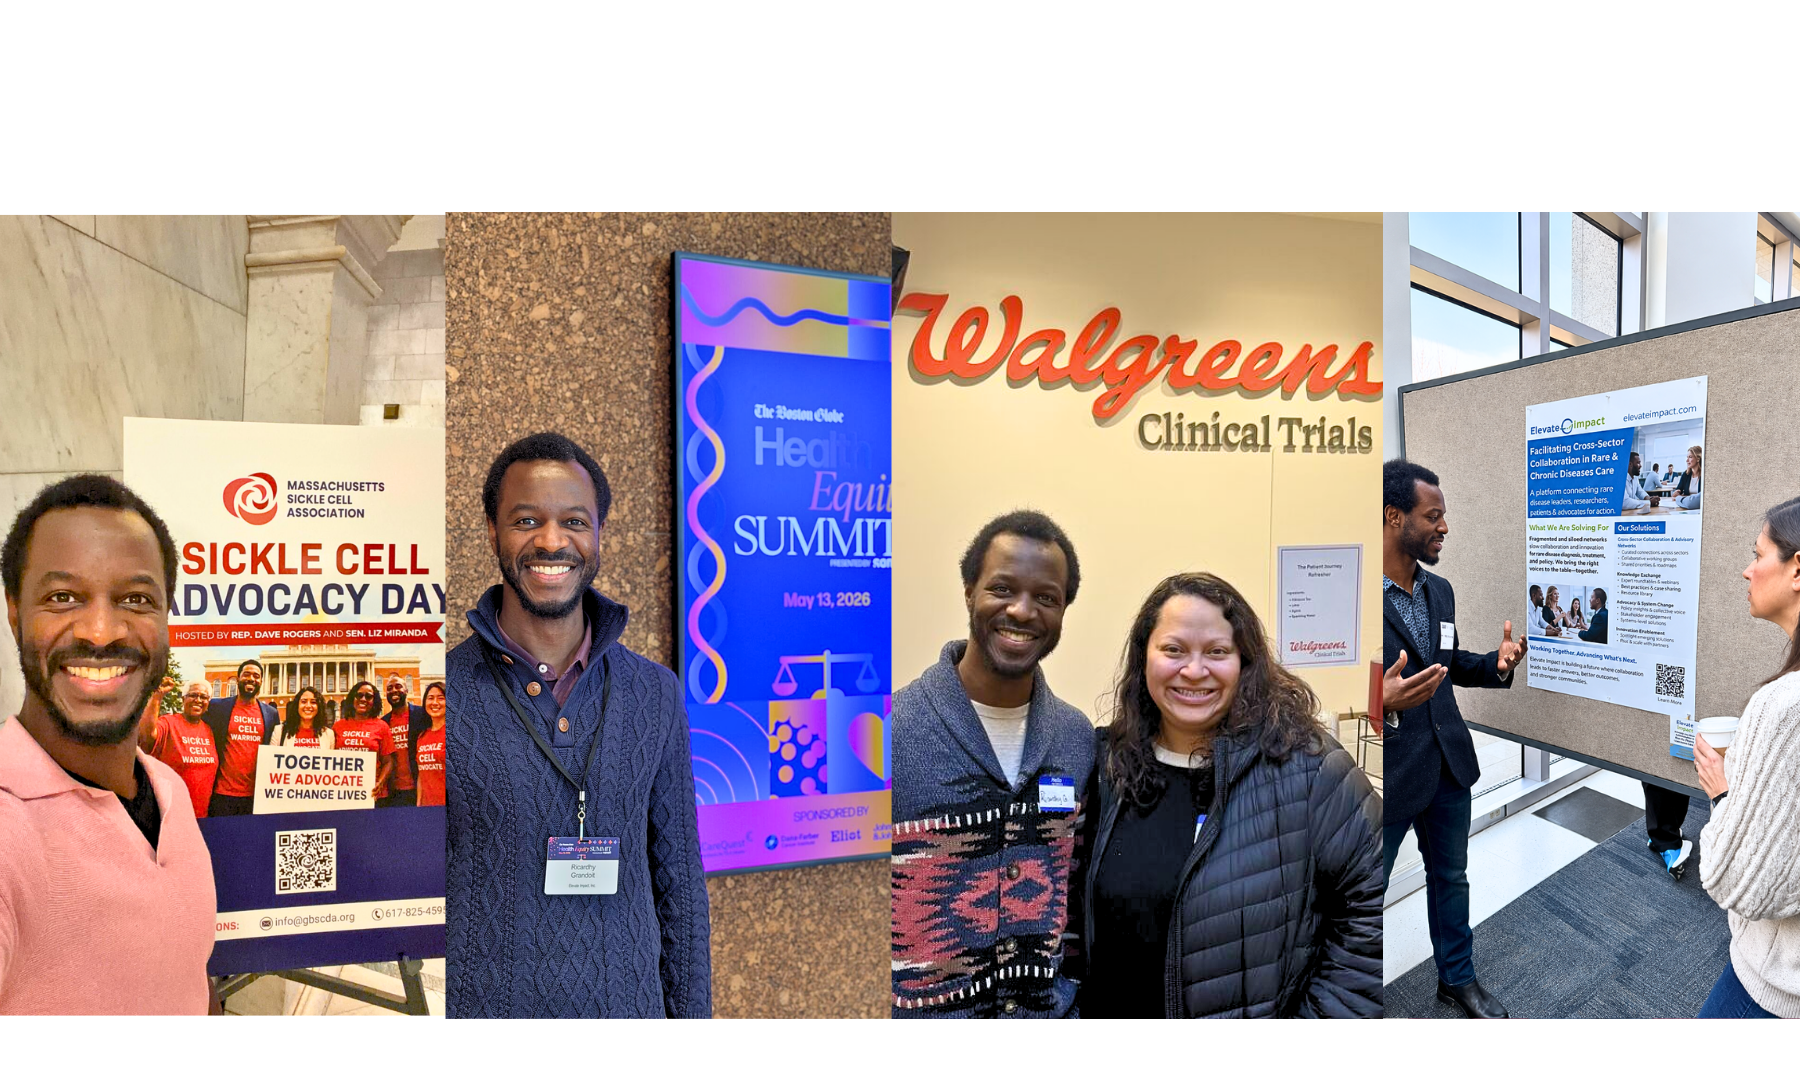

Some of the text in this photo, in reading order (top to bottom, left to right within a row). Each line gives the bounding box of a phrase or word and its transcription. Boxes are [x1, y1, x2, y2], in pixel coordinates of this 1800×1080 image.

[901, 293, 1383, 419] Walgreens
[754, 403, 844, 423] The Boston Globe
[1623, 404, 1697, 422] elevateimpact.com
[1138, 410, 1372, 452] Clinical Trials
[1530, 423, 1560, 435] Elevate
[755, 425, 872, 470] Health
[1530, 437, 1625, 456] Facilitating Cross-Sector
[1530, 452, 1619, 468] Collaboration in Rare &
[1530, 466, 1615, 480] Chronic Diseases Care
[287, 480, 385, 493] MASSACHUSETTS
[1535, 488, 1562, 498] platform
[1563, 486, 1599, 496] connecting
[1600, 485, 1614, 493] rare
[287, 494, 353, 505] SICKLE CELL
[1529, 496, 1609, 506] disease leaders, researchers,
[286, 507, 365, 519] ASSOCIATION
[1529, 507, 1616, 517] patients & advocates for action.
[1571, 523, 1596, 532] Solving
[1617, 524, 1660, 532] Our Solutions
[182, 542, 429, 576] SICKLE CELL
[783, 591, 871, 610] May 13, 2026
[175, 628, 428, 640] HOSTED BY REP. DAVE ROGERS AND SEN. LIZ MIRANDA
[1289, 640, 1347, 654] Walgreens
[1529, 644, 1552, 654] Working
[1552, 647, 1575, 656] Together.
[1576, 651, 1603, 660] Advancing
[1603, 654, 1622, 662] What's
[1565, 661, 1583, 669] building
[1600, 665, 1614, 673] where
[1614, 667, 1644, 677] collaboration
[1539, 673, 1557, 681] stronger
[1558, 675, 1588, 685] communities.
[234, 715, 262, 725] SICKLE
[1676, 719, 1694, 728] Elevate
[238, 725, 259, 734] CELL
[342, 730, 371, 738] SICKLE
[181, 736, 211, 746] SICKLE
[231, 733, 261, 742] WARRIOR
[344, 738, 365, 746] CELL
[189, 746, 210, 755] CELL
[418, 742, 444, 753] SICKLE
[182, 755, 215, 764] WARRIOR
[273, 753, 365, 772] TOGETHER
[418, 753, 436, 762] CELL
[418, 763, 443, 771] DVOCATE
[269, 772, 364, 787] WE ADVOCATE
[264, 788, 367, 801] WE CHANGE LIVES
[793, 805, 870, 822] SPONSORED BY
[830, 829, 862, 843] Eliot
[275, 912, 356, 929] info@gbscda.org
